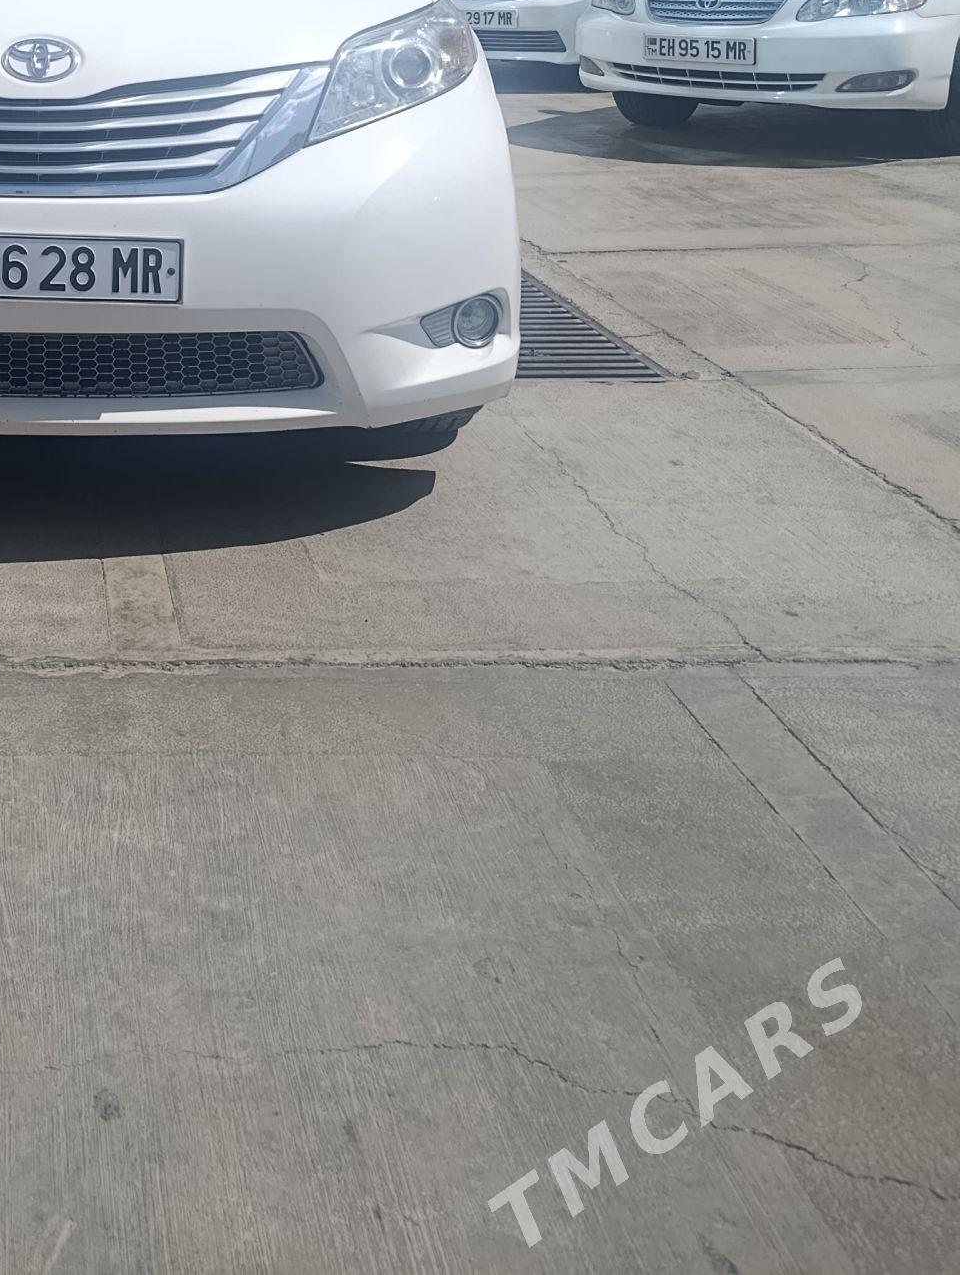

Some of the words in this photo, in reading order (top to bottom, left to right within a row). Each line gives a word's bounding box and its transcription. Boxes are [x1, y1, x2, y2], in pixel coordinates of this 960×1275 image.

[466, 11, 480, 25] 29
[483, 11, 495, 25] 17
[498, 11, 512, 25] MR
[660, 38, 675, 56] EH
[679, 39, 699, 57] 95
[704, 40, 721, 59] 15
[725, 41, 746, 60] MR
[39, 245, 95, 292] 28
[111, 247, 162, 294] MR
